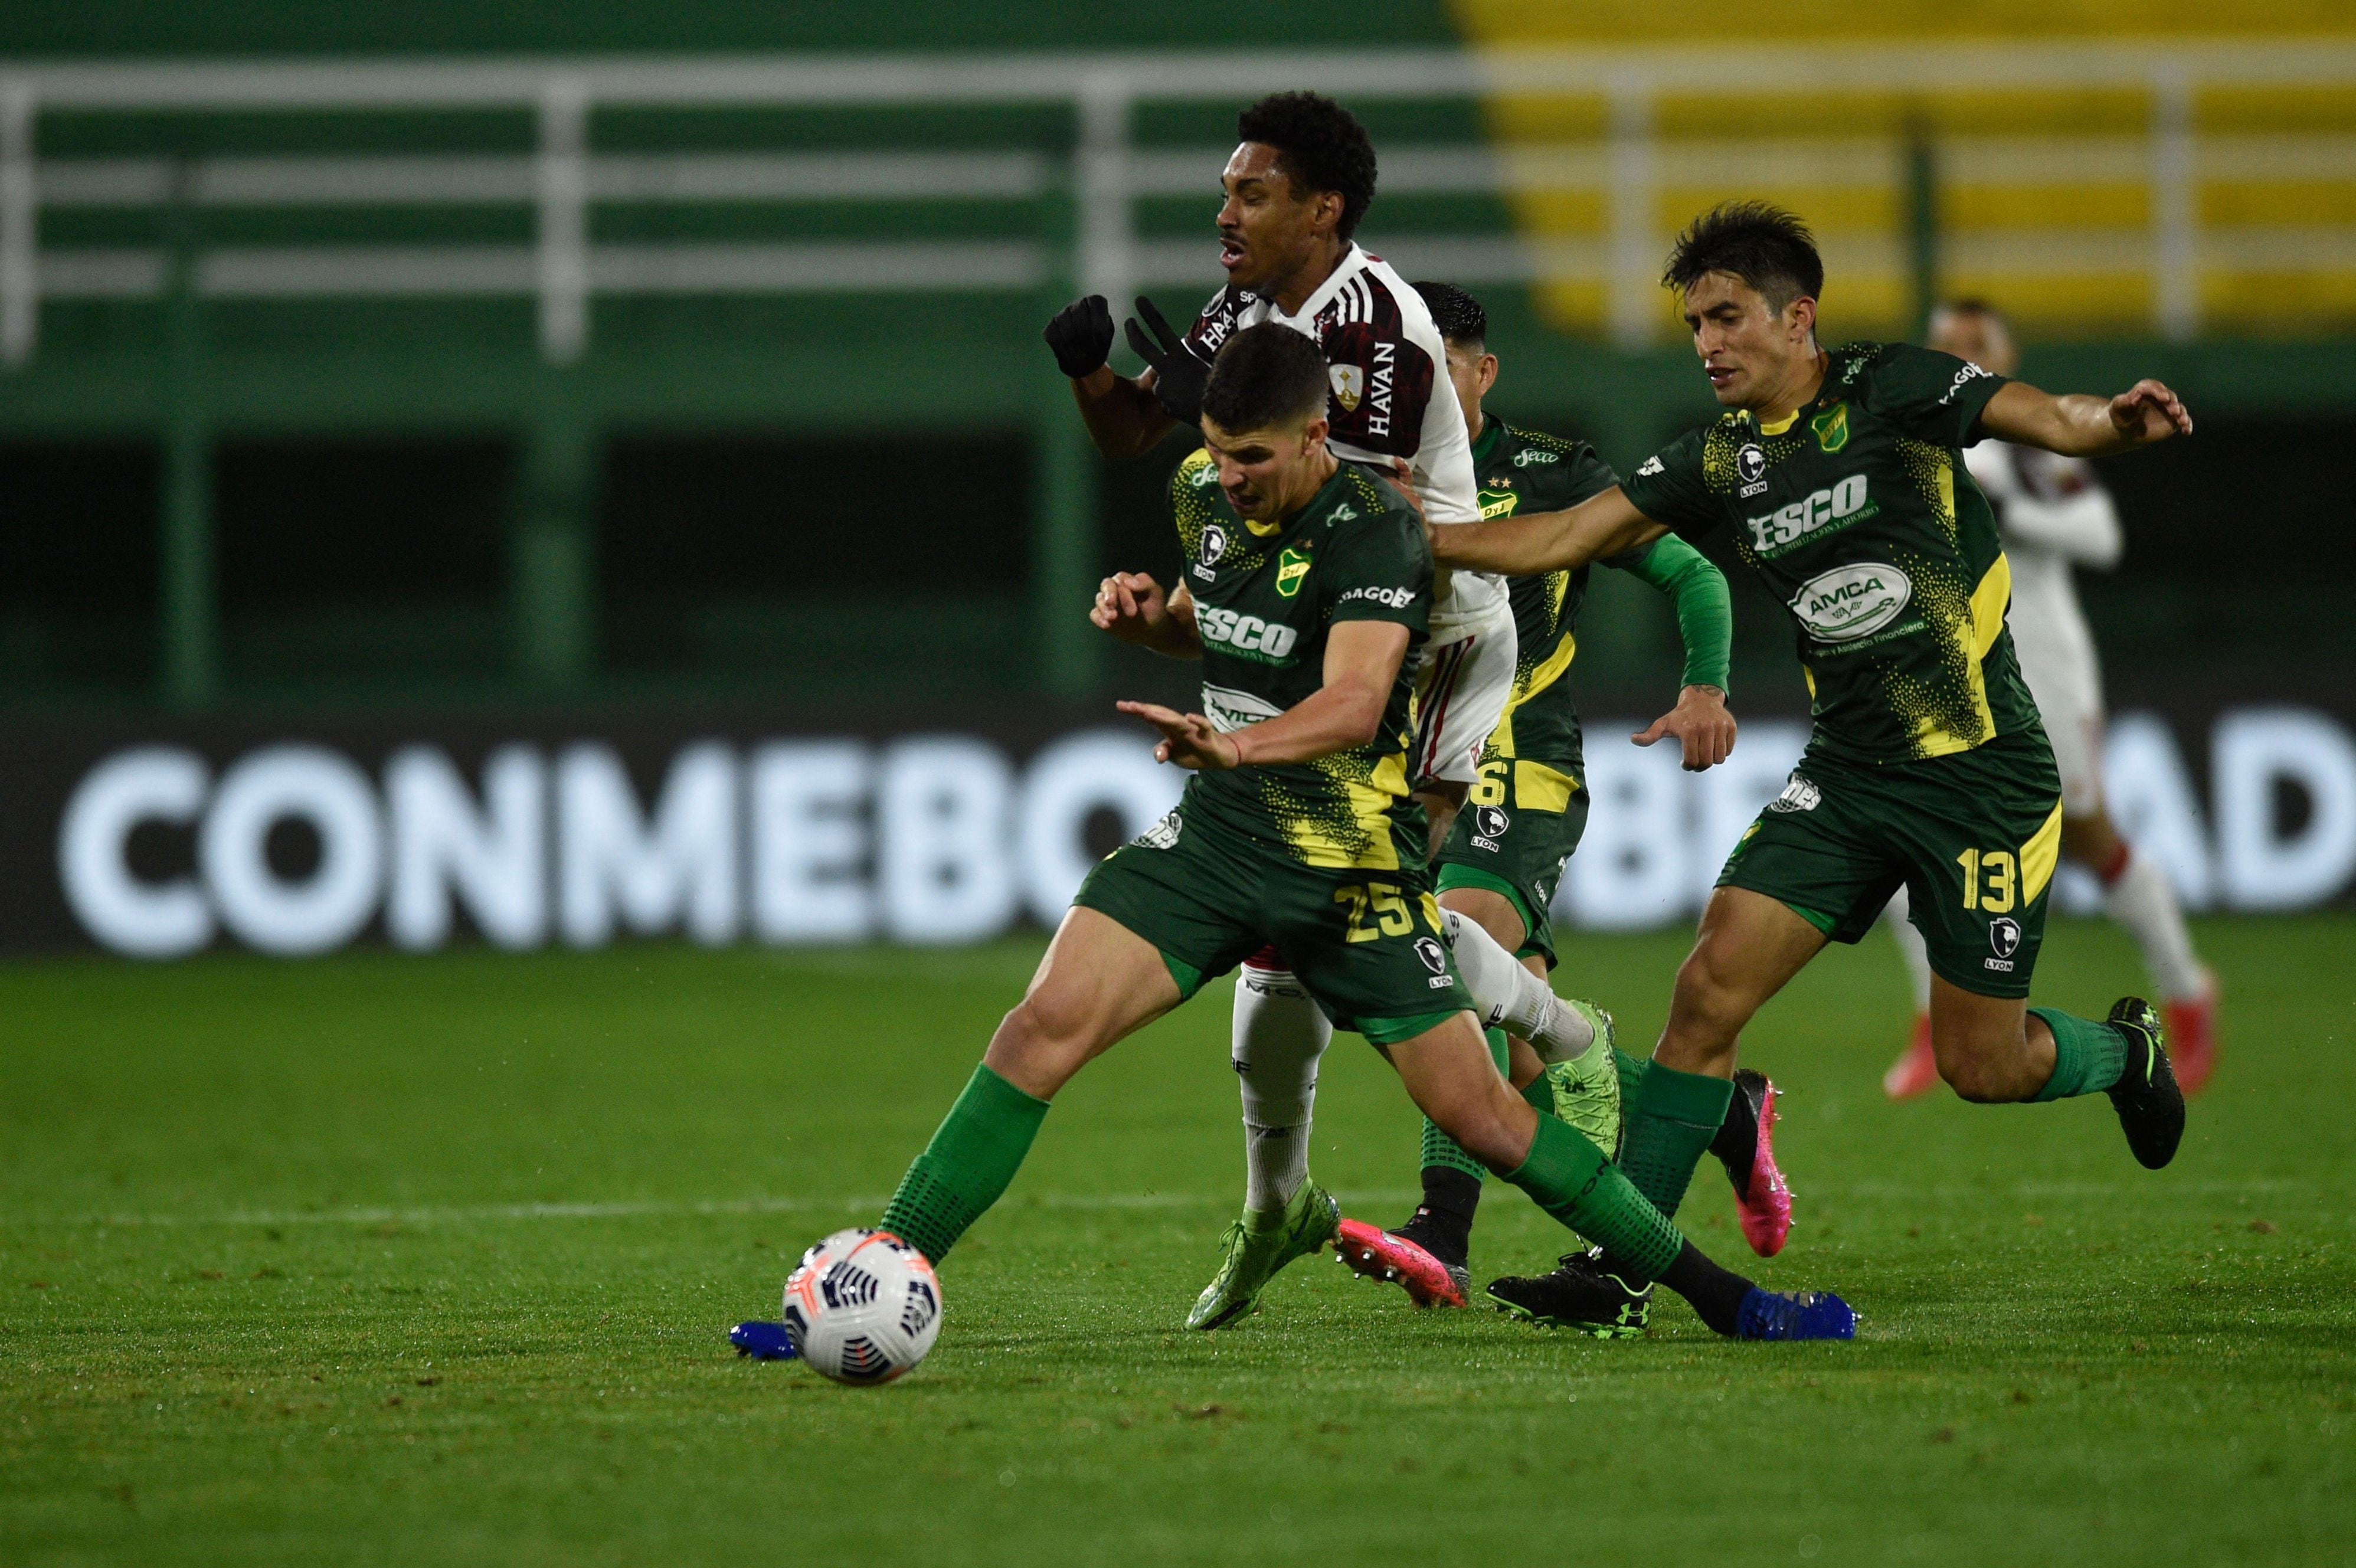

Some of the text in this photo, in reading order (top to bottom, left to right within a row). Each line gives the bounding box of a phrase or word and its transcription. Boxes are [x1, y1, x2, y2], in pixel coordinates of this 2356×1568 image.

[1368, 341, 1395, 438] HAVAN
[1514, 448, 1559, 467] Secco
[1740, 481, 1768, 498] LYON
[1484, 503, 1504, 517] DyJ
[1843, 505, 1880, 528] AHORRO
[1194, 559, 1216, 582] LYON
[1810, 577, 1886, 616] AMCA
[1874, 620, 1925, 643] Financiera
[59, 729, 1198, 960] CONMEBO
[1471, 836, 1499, 853] LYON
[1534, 879, 1547, 905] LYON
[1956, 848, 2015, 914] 13
[1334, 882, 1414, 943] 25
[1985, 958, 2014, 971] LYON
